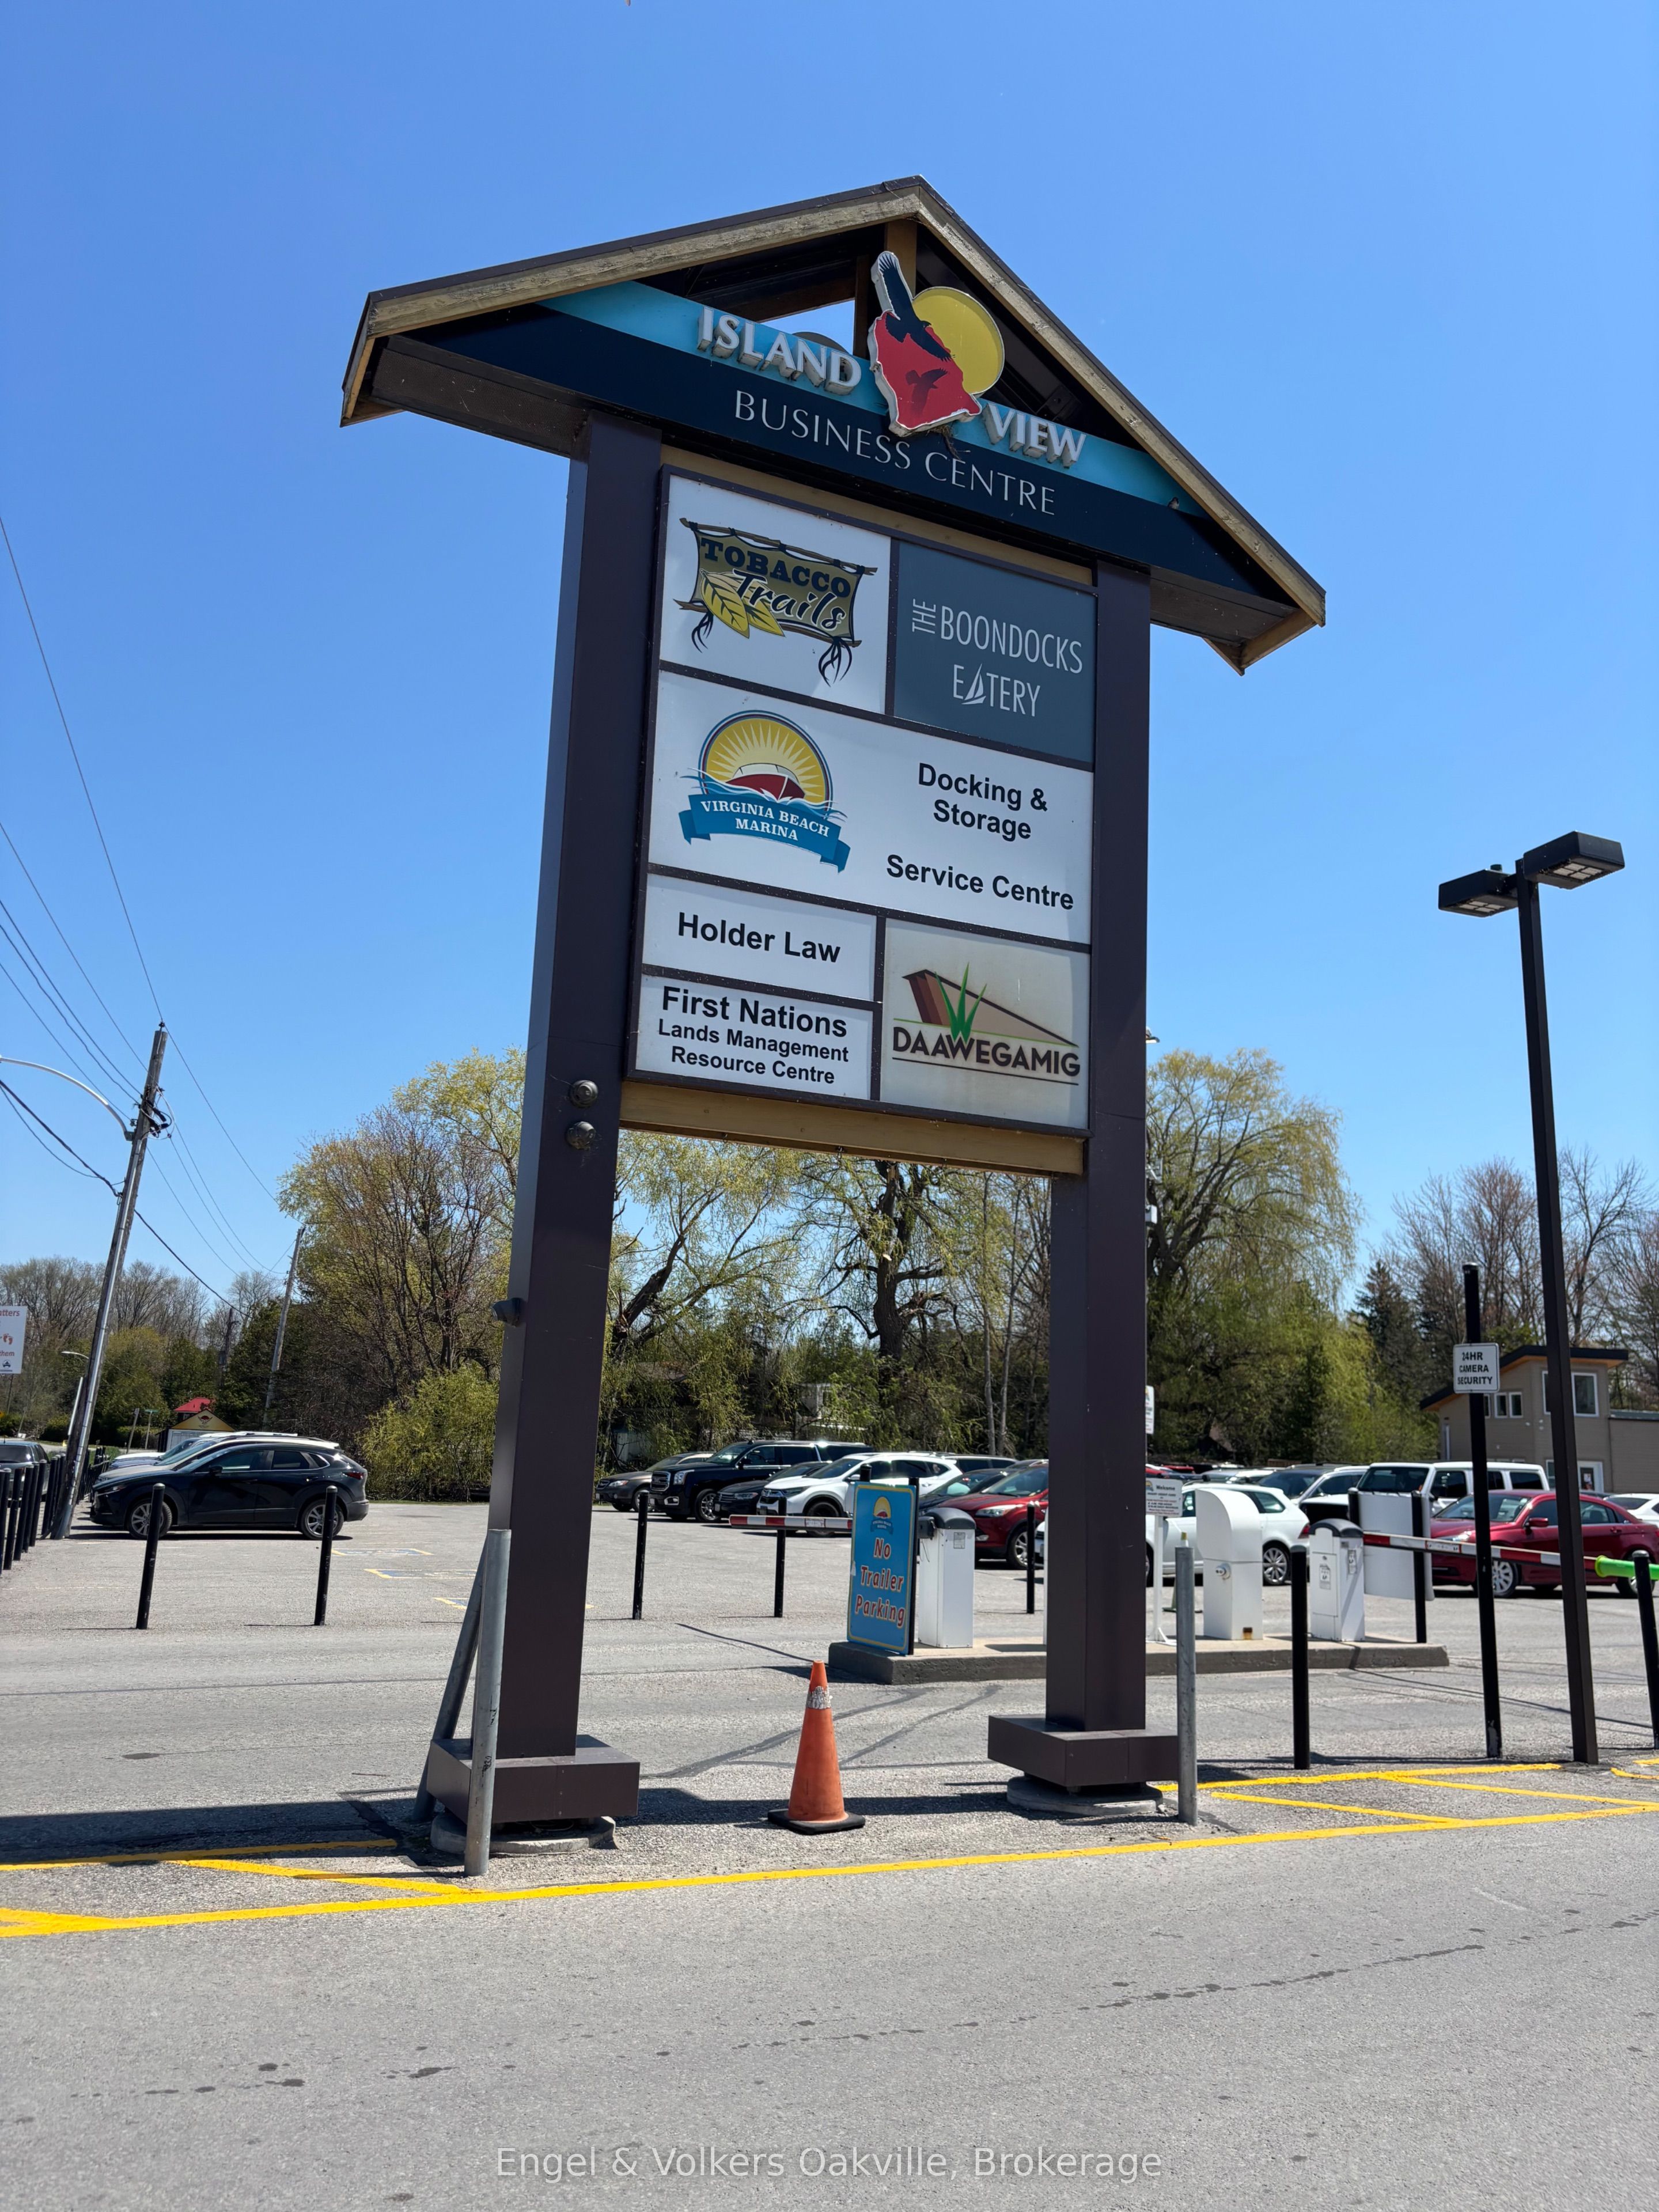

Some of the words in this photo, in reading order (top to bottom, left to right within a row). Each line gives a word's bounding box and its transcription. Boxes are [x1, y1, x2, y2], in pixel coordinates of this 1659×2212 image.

[698, 306, 862, 395] ISLAND
[982, 402, 1086, 468] VIEW
[735, 390, 911, 469] BUSINESS
[925, 452, 1055, 515] CENTRE
[700, 537, 851, 597] TOBACCO
[733, 569, 846, 631] Trails
[912, 599, 936, 634] THE
[941, 605, 1082, 673] BOONDOCKS
[919, 762, 1021, 812] Docking
[1030, 788, 1048, 812] &
[700, 801, 774, 819] VIRGINIA
[779, 810, 830, 837] BEACH
[735, 818, 798, 841] MARINA
[933, 799, 1031, 842] Storage
[887, 854, 983, 893] Service
[993, 875, 1074, 910] Centre
[678, 912, 775, 952] Holder
[785, 931, 841, 963] Law
[662, 986, 730, 1020] First
[740, 998, 847, 1037] Nations
[658, 1018, 719, 1043] Lands
[726, 1028, 849, 1062] Management
[893, 1027, 1080, 1077] DAAWEGAMIG
[672, 1046, 766, 1075] Resource
[772, 1060, 835, 1084] Centre
[1459, 1364, 1489, 1373] CAMERA
[1462, 1351, 1483, 1361] 24HR
[1457, 1376, 1493, 1385] SECURITY
[873, 1537, 892, 1559] No
[861, 1566, 904, 1592] Trailer
[855, 1594, 906, 1628] Parking
